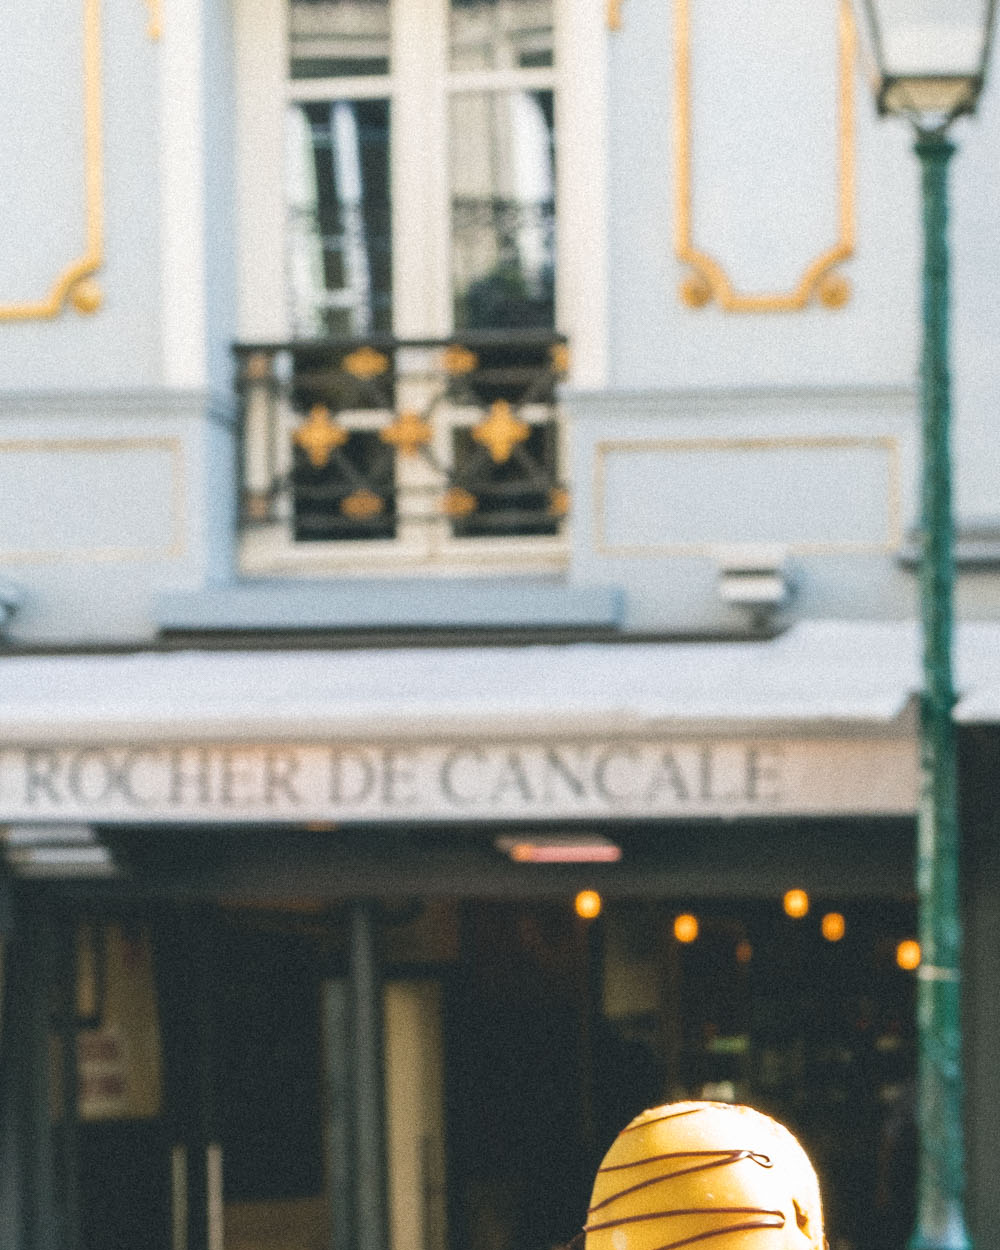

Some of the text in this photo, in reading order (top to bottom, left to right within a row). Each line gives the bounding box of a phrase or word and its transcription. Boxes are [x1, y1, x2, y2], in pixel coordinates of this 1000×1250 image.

[23, 744, 783, 807] ROCHER DE CANCALE
